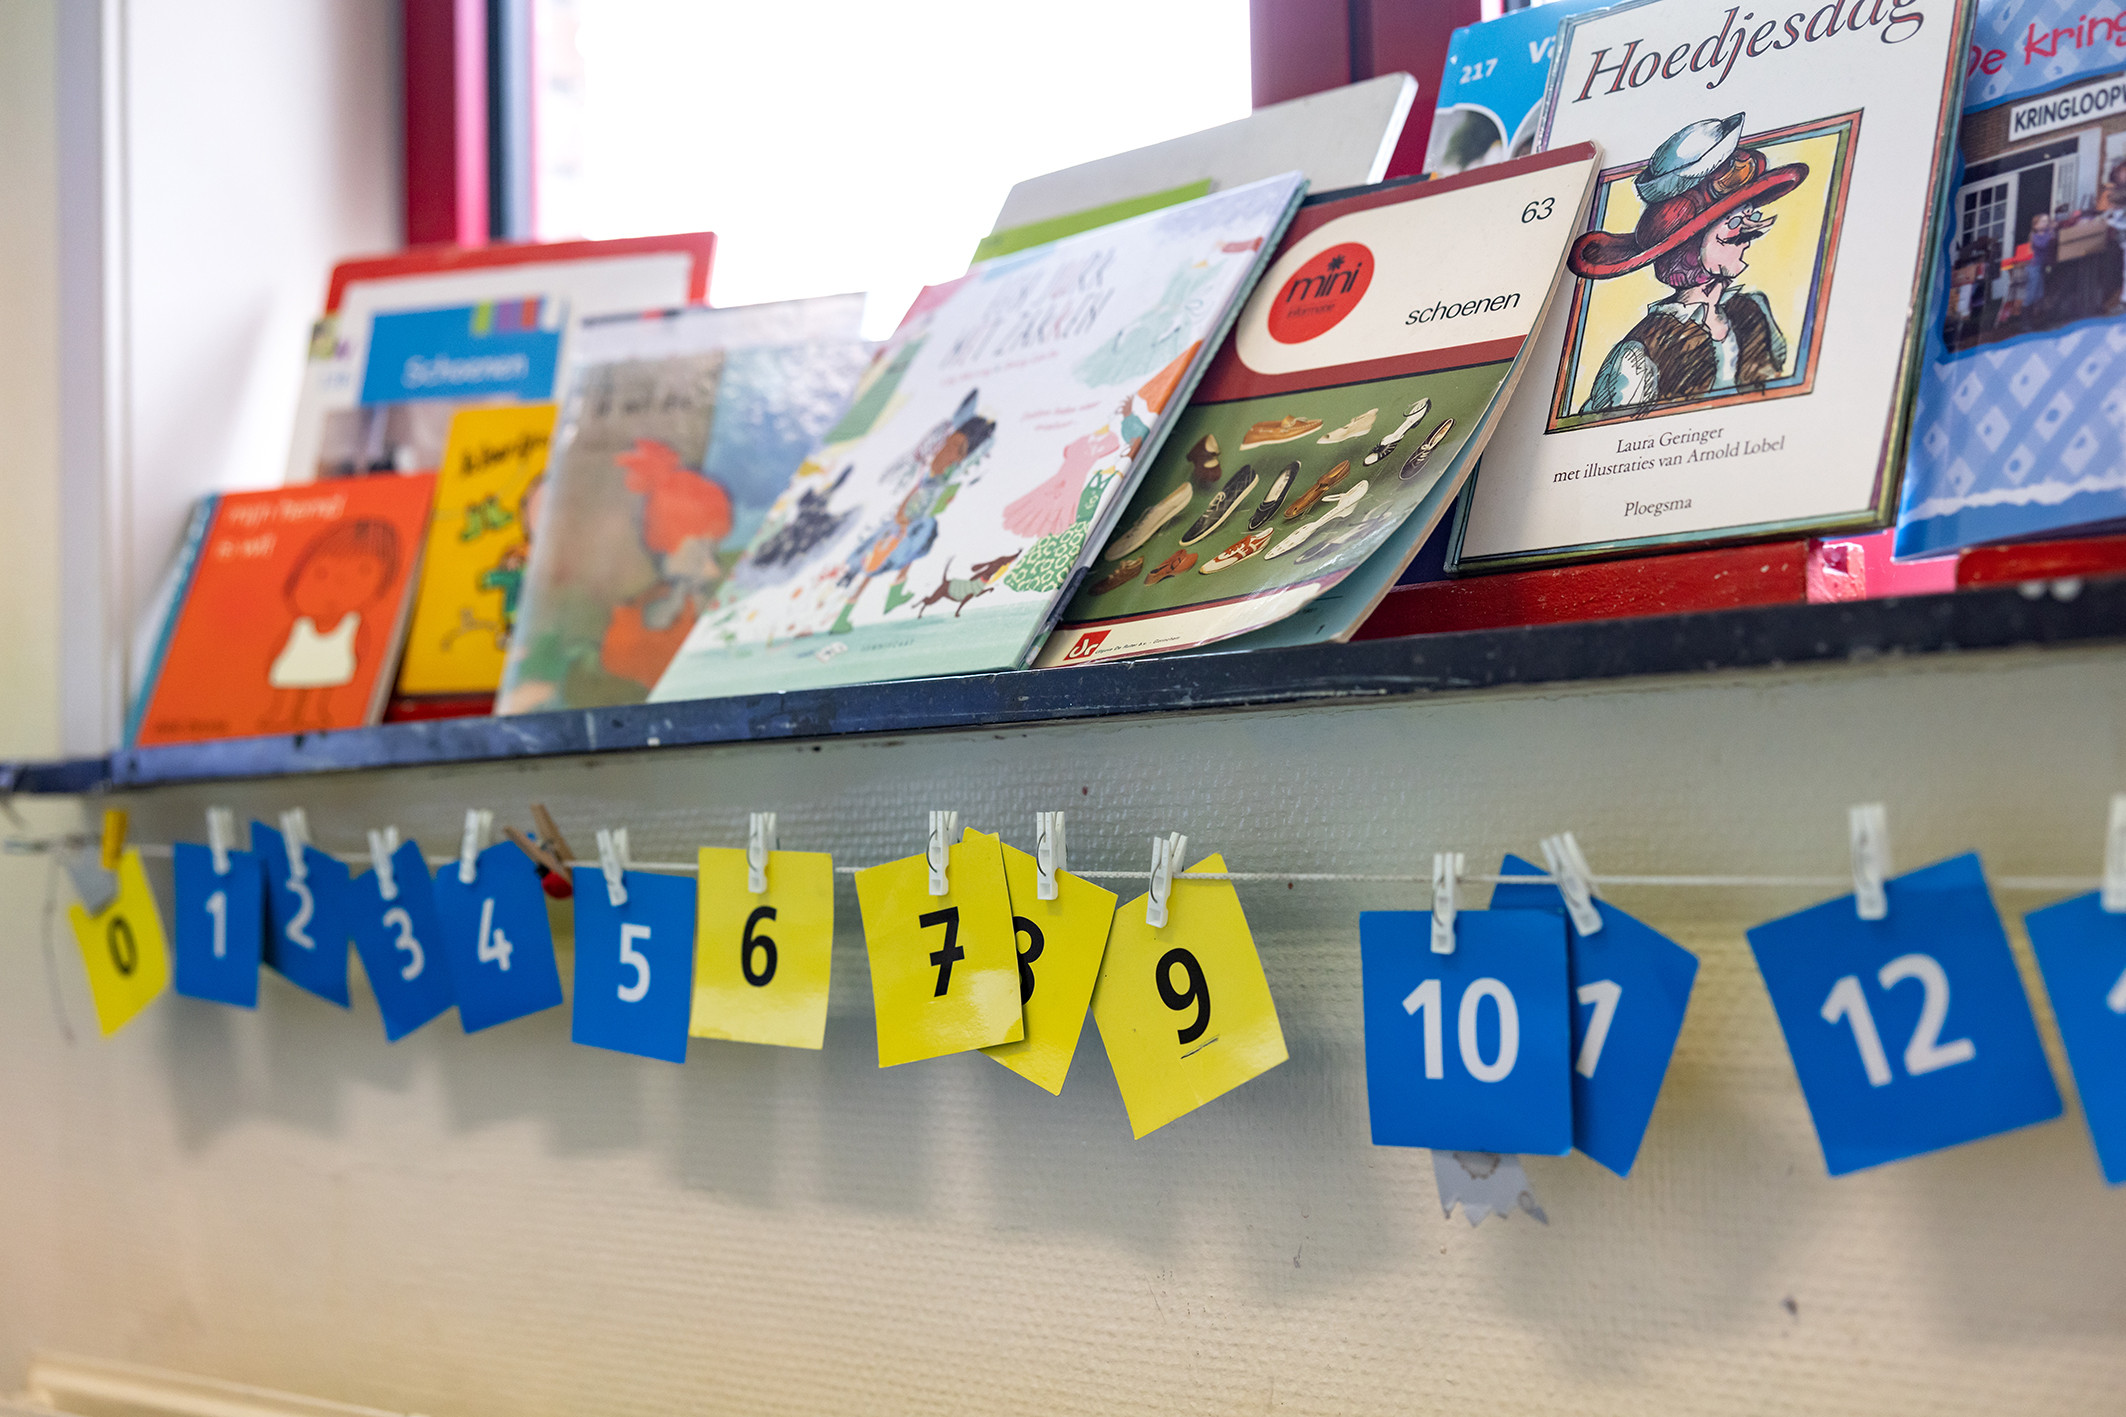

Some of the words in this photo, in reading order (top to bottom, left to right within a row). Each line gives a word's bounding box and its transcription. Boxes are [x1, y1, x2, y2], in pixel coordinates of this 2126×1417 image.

[1459, 57, 1498, 85] 217
[1572, 0, 1924, 102] Hoedjesdag
[2014, 84, 2126, 134] KRINGLOOP
[1521, 197, 1556, 224] 63
[1286, 260, 1363, 303] mini
[1405, 292, 1522, 326] schoenen
[1553, 469, 1580, 483] met
[1583, 456, 1656, 479] illustraties
[1659, 455, 1682, 467] van
[1686, 442, 1740, 464] Arnold
[1743, 435, 1786, 455] Lobel
[1616, 438, 1655, 454] Laura
[1659, 427, 1725, 447] Geringer
[1624, 497, 1693, 517] Ploegsma
[1068, 638, 1100, 659] dr
[106, 915, 140, 979] 0
[206, 890, 228, 959] 1
[286, 878, 317, 951] 2
[382, 906, 426, 982] 3
[477, 897, 514, 972] 4
[741, 906, 778, 988] 6
[617, 922, 652, 1003] 5
[918, 906, 965, 998] 7
[1154, 947, 1212, 1045] 9
[1402, 977, 1521, 1083] 10
[1576, 978, 1623, 1079] 1
[1820, 953, 1977, 1088] 12
